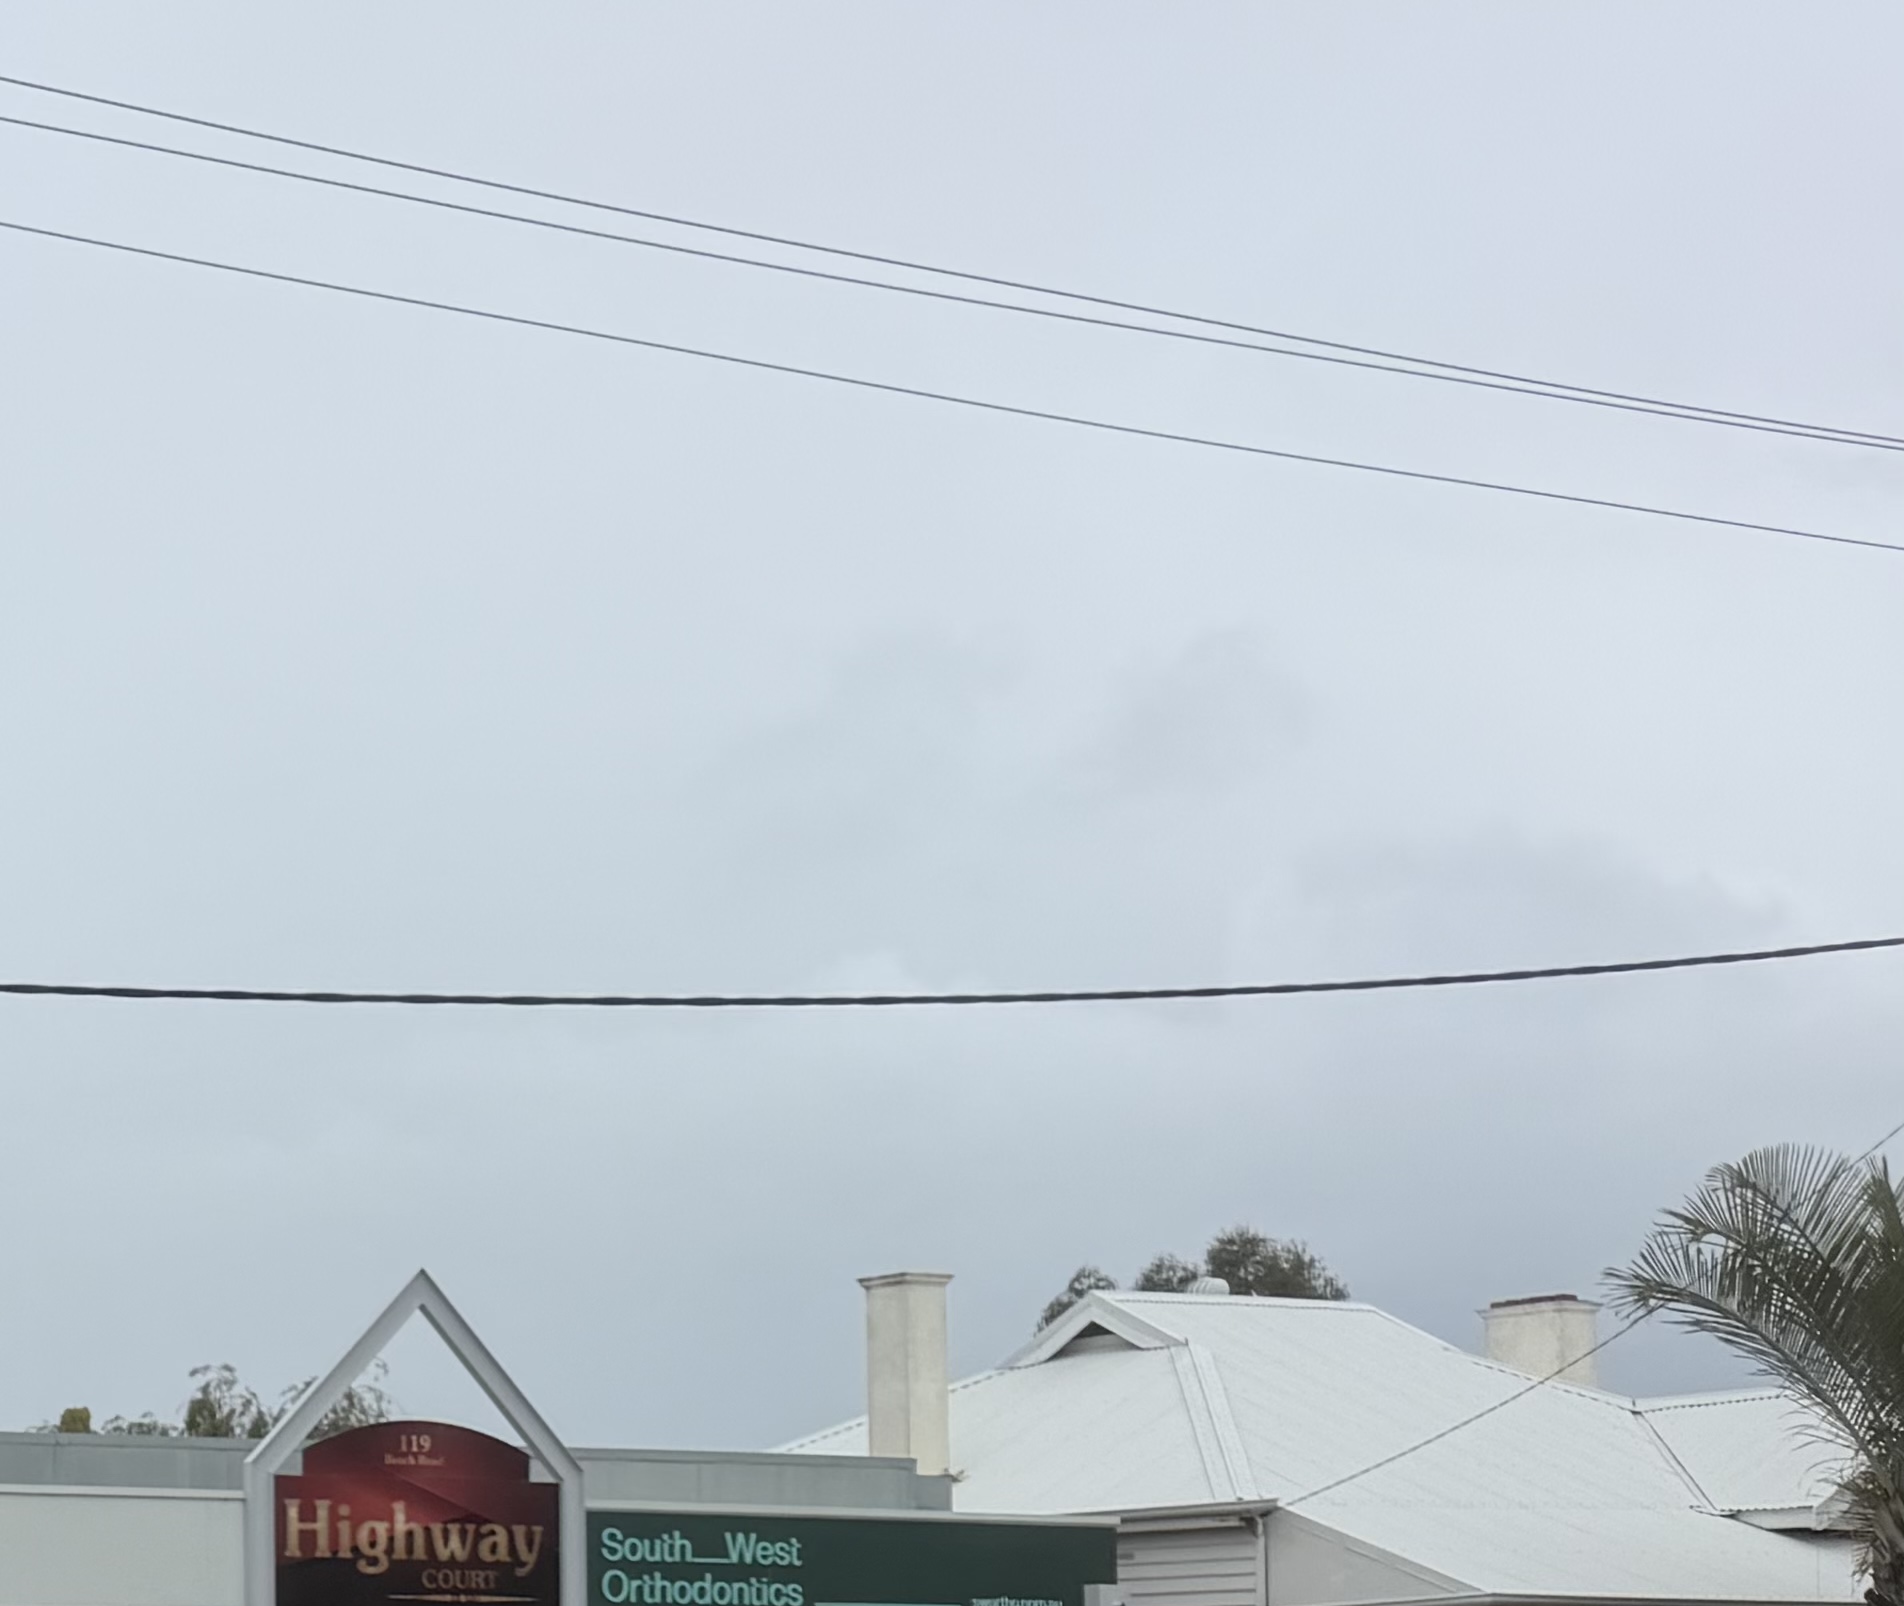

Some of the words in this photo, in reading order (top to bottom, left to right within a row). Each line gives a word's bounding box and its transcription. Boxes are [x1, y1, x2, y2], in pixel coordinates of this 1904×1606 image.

[400, 1434, 432, 1453] 119
[283, 1498, 544, 1577] Highway
[421, 1569, 498, 1590] COURT
